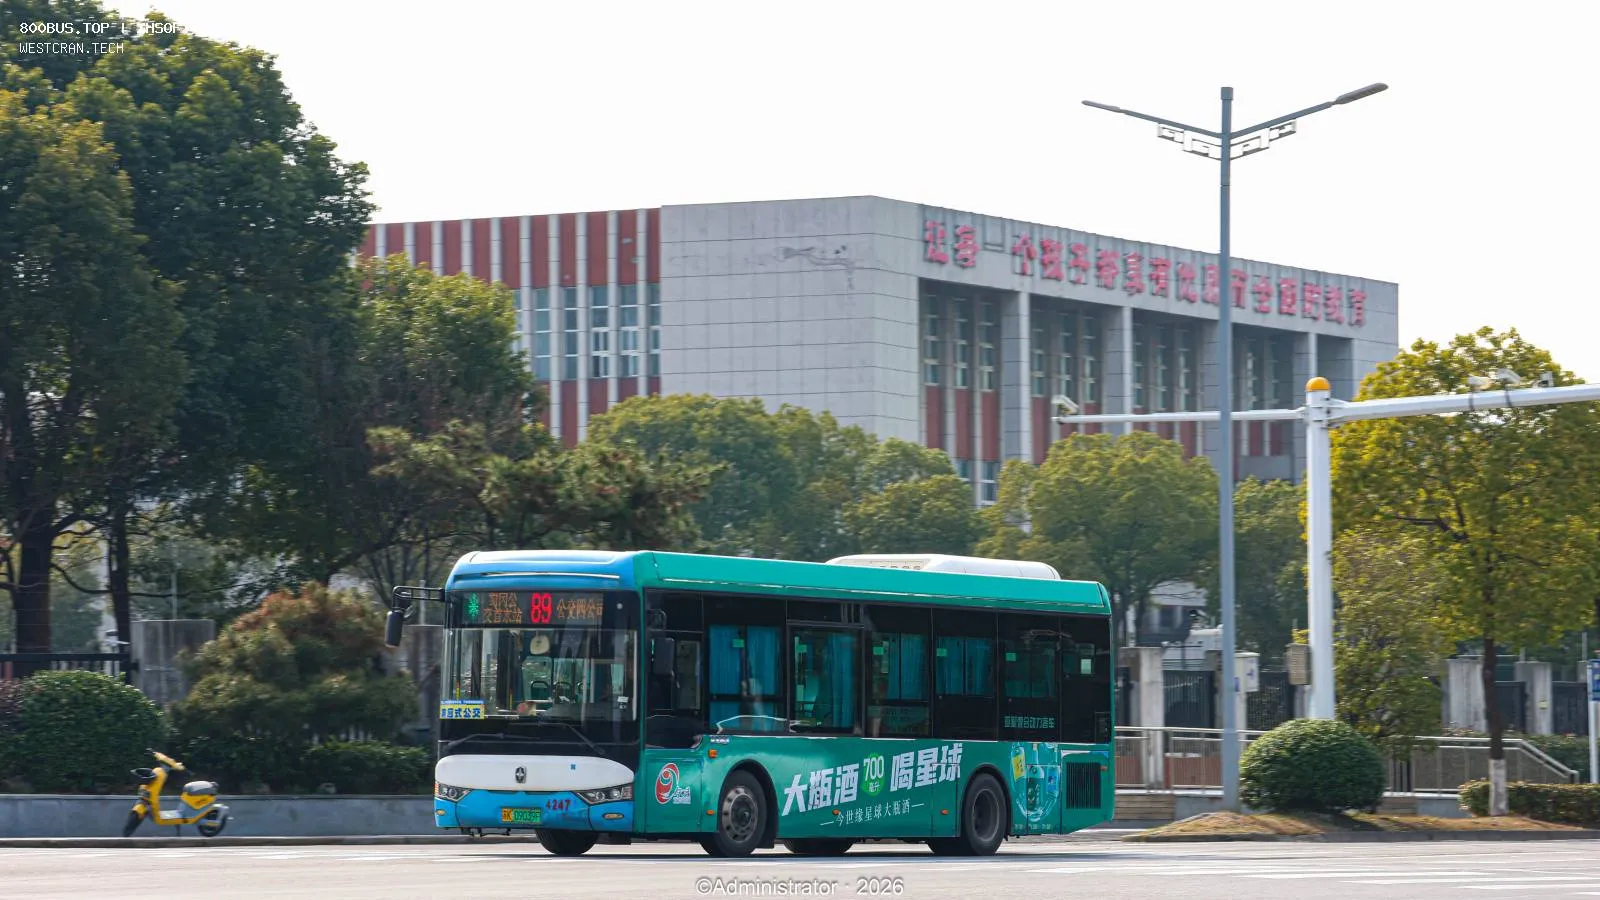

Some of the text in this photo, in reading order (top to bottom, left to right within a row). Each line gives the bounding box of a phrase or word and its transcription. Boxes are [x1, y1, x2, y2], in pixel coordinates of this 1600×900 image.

[530, 591, 553, 624] 89
[781, 763, 860, 817] 大瓶酒
[863, 755, 885, 782] 700
[889, 742, 964, 793] 喝星球
[546, 798, 571, 812] 4247
[835, 798, 911, 828] 今世缘星球大瓶酒
